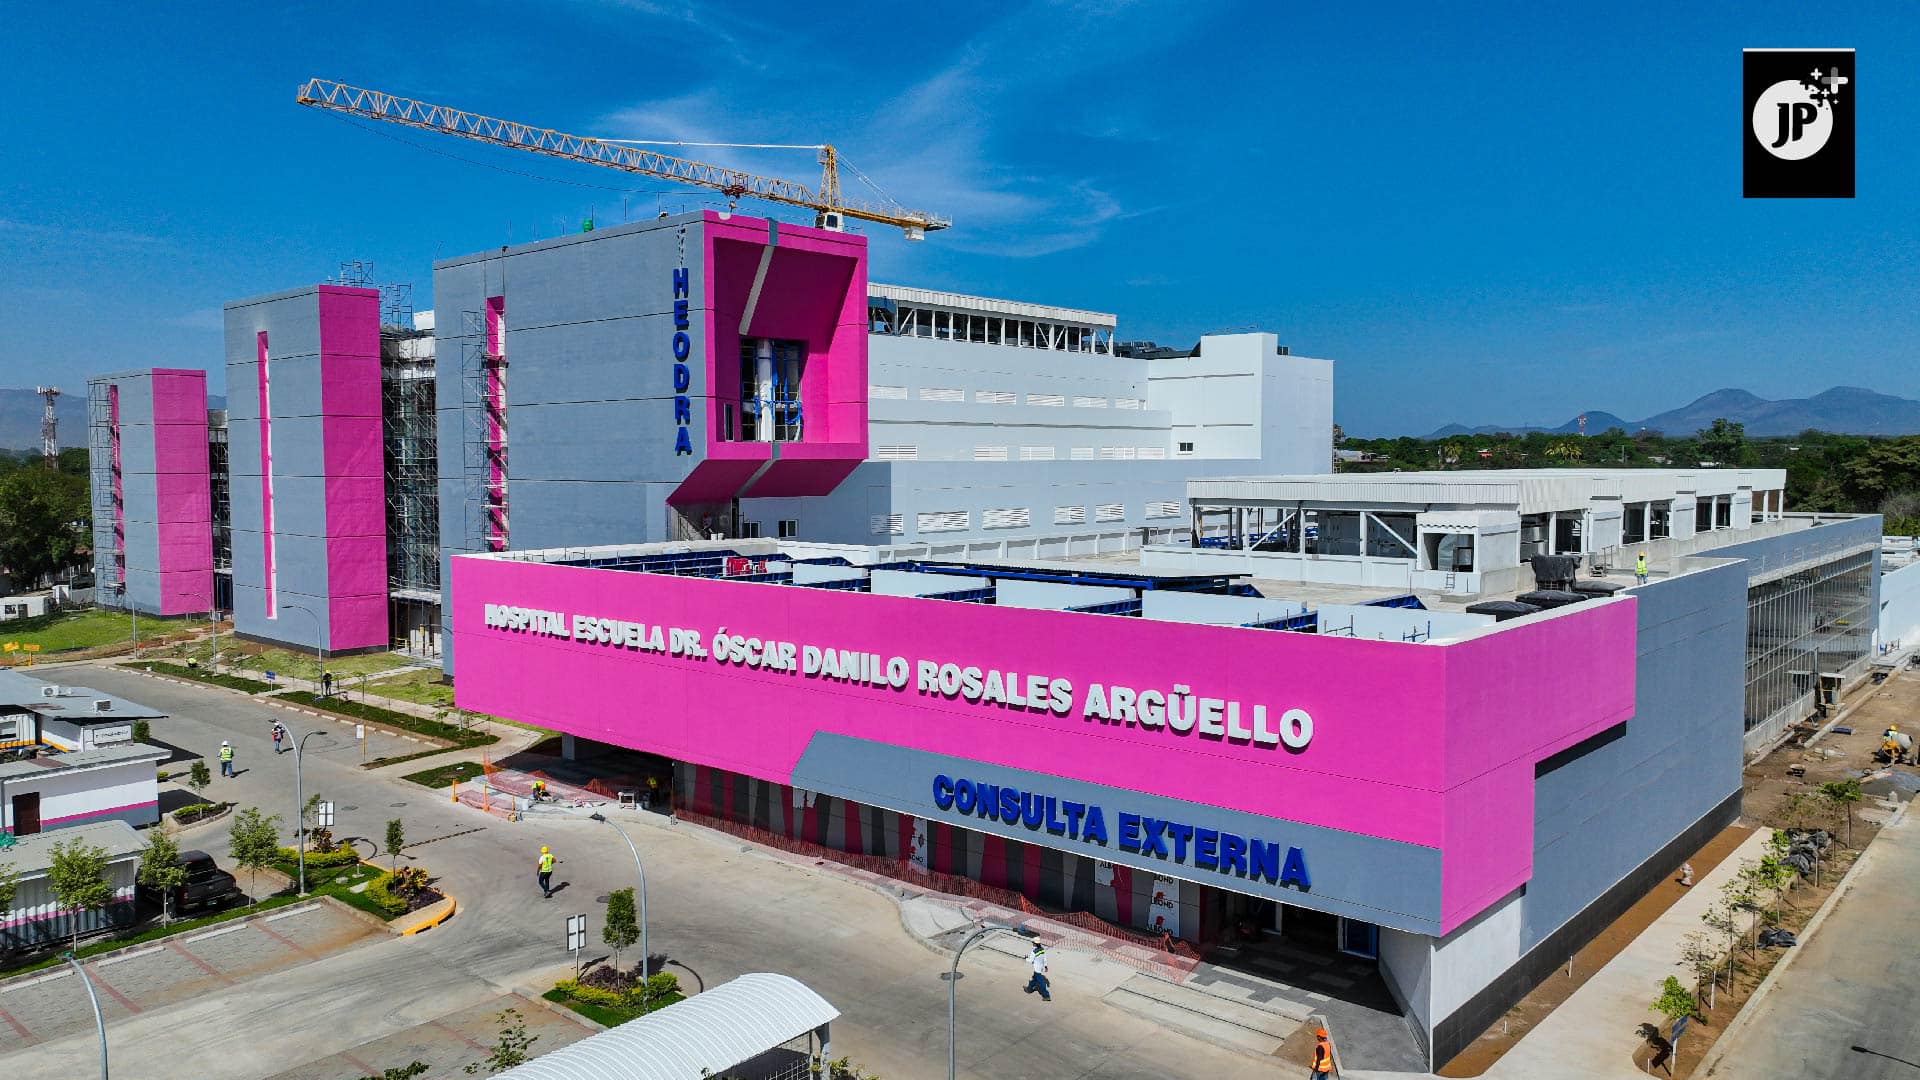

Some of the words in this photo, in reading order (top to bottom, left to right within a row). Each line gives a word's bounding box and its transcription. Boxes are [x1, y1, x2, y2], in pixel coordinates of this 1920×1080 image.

[673, 267, 692, 456] HEODRA
[484, 604, 570, 637] HOSPITAL
[573, 615, 665, 652] ESCUELA
[669, 627, 708, 657] DR.
[712, 627, 797, 671] ÓSCAR
[803, 644, 910, 688] DANILO
[917, 659, 1073, 713] ROSALES
[1083, 684, 1314, 751] ARGÜELLO
[932, 774, 1108, 846] CONSULTA
[1118, 811, 1311, 891] EXTERNA
